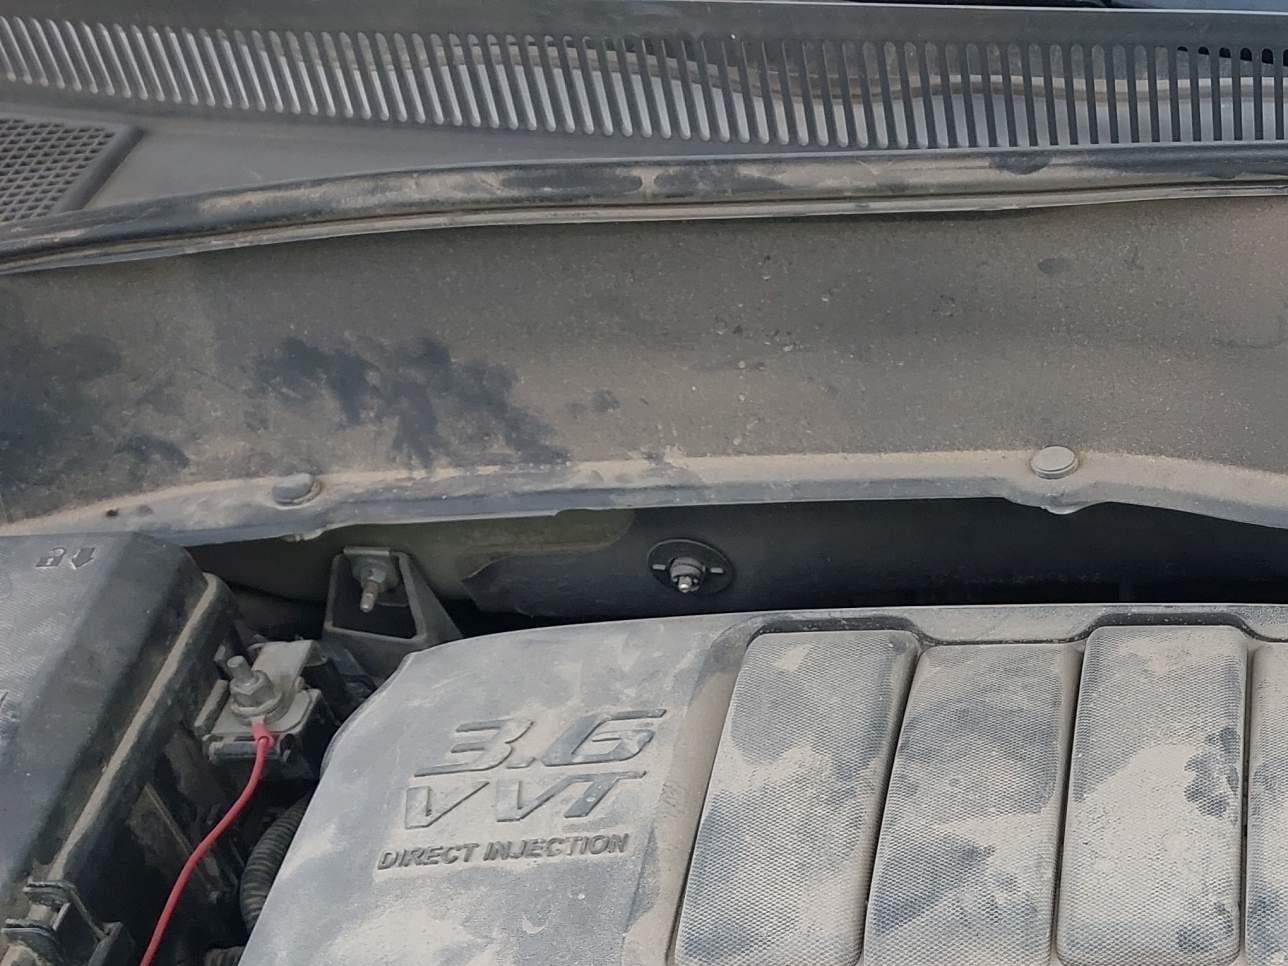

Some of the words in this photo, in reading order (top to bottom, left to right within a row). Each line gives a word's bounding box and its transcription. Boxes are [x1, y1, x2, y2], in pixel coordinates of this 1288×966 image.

[413, 708, 668, 778] 3.6
[404, 769, 648, 831] VVT
[376, 842, 480, 870] DIRECT
[483, 832, 630, 862] INJECTION
